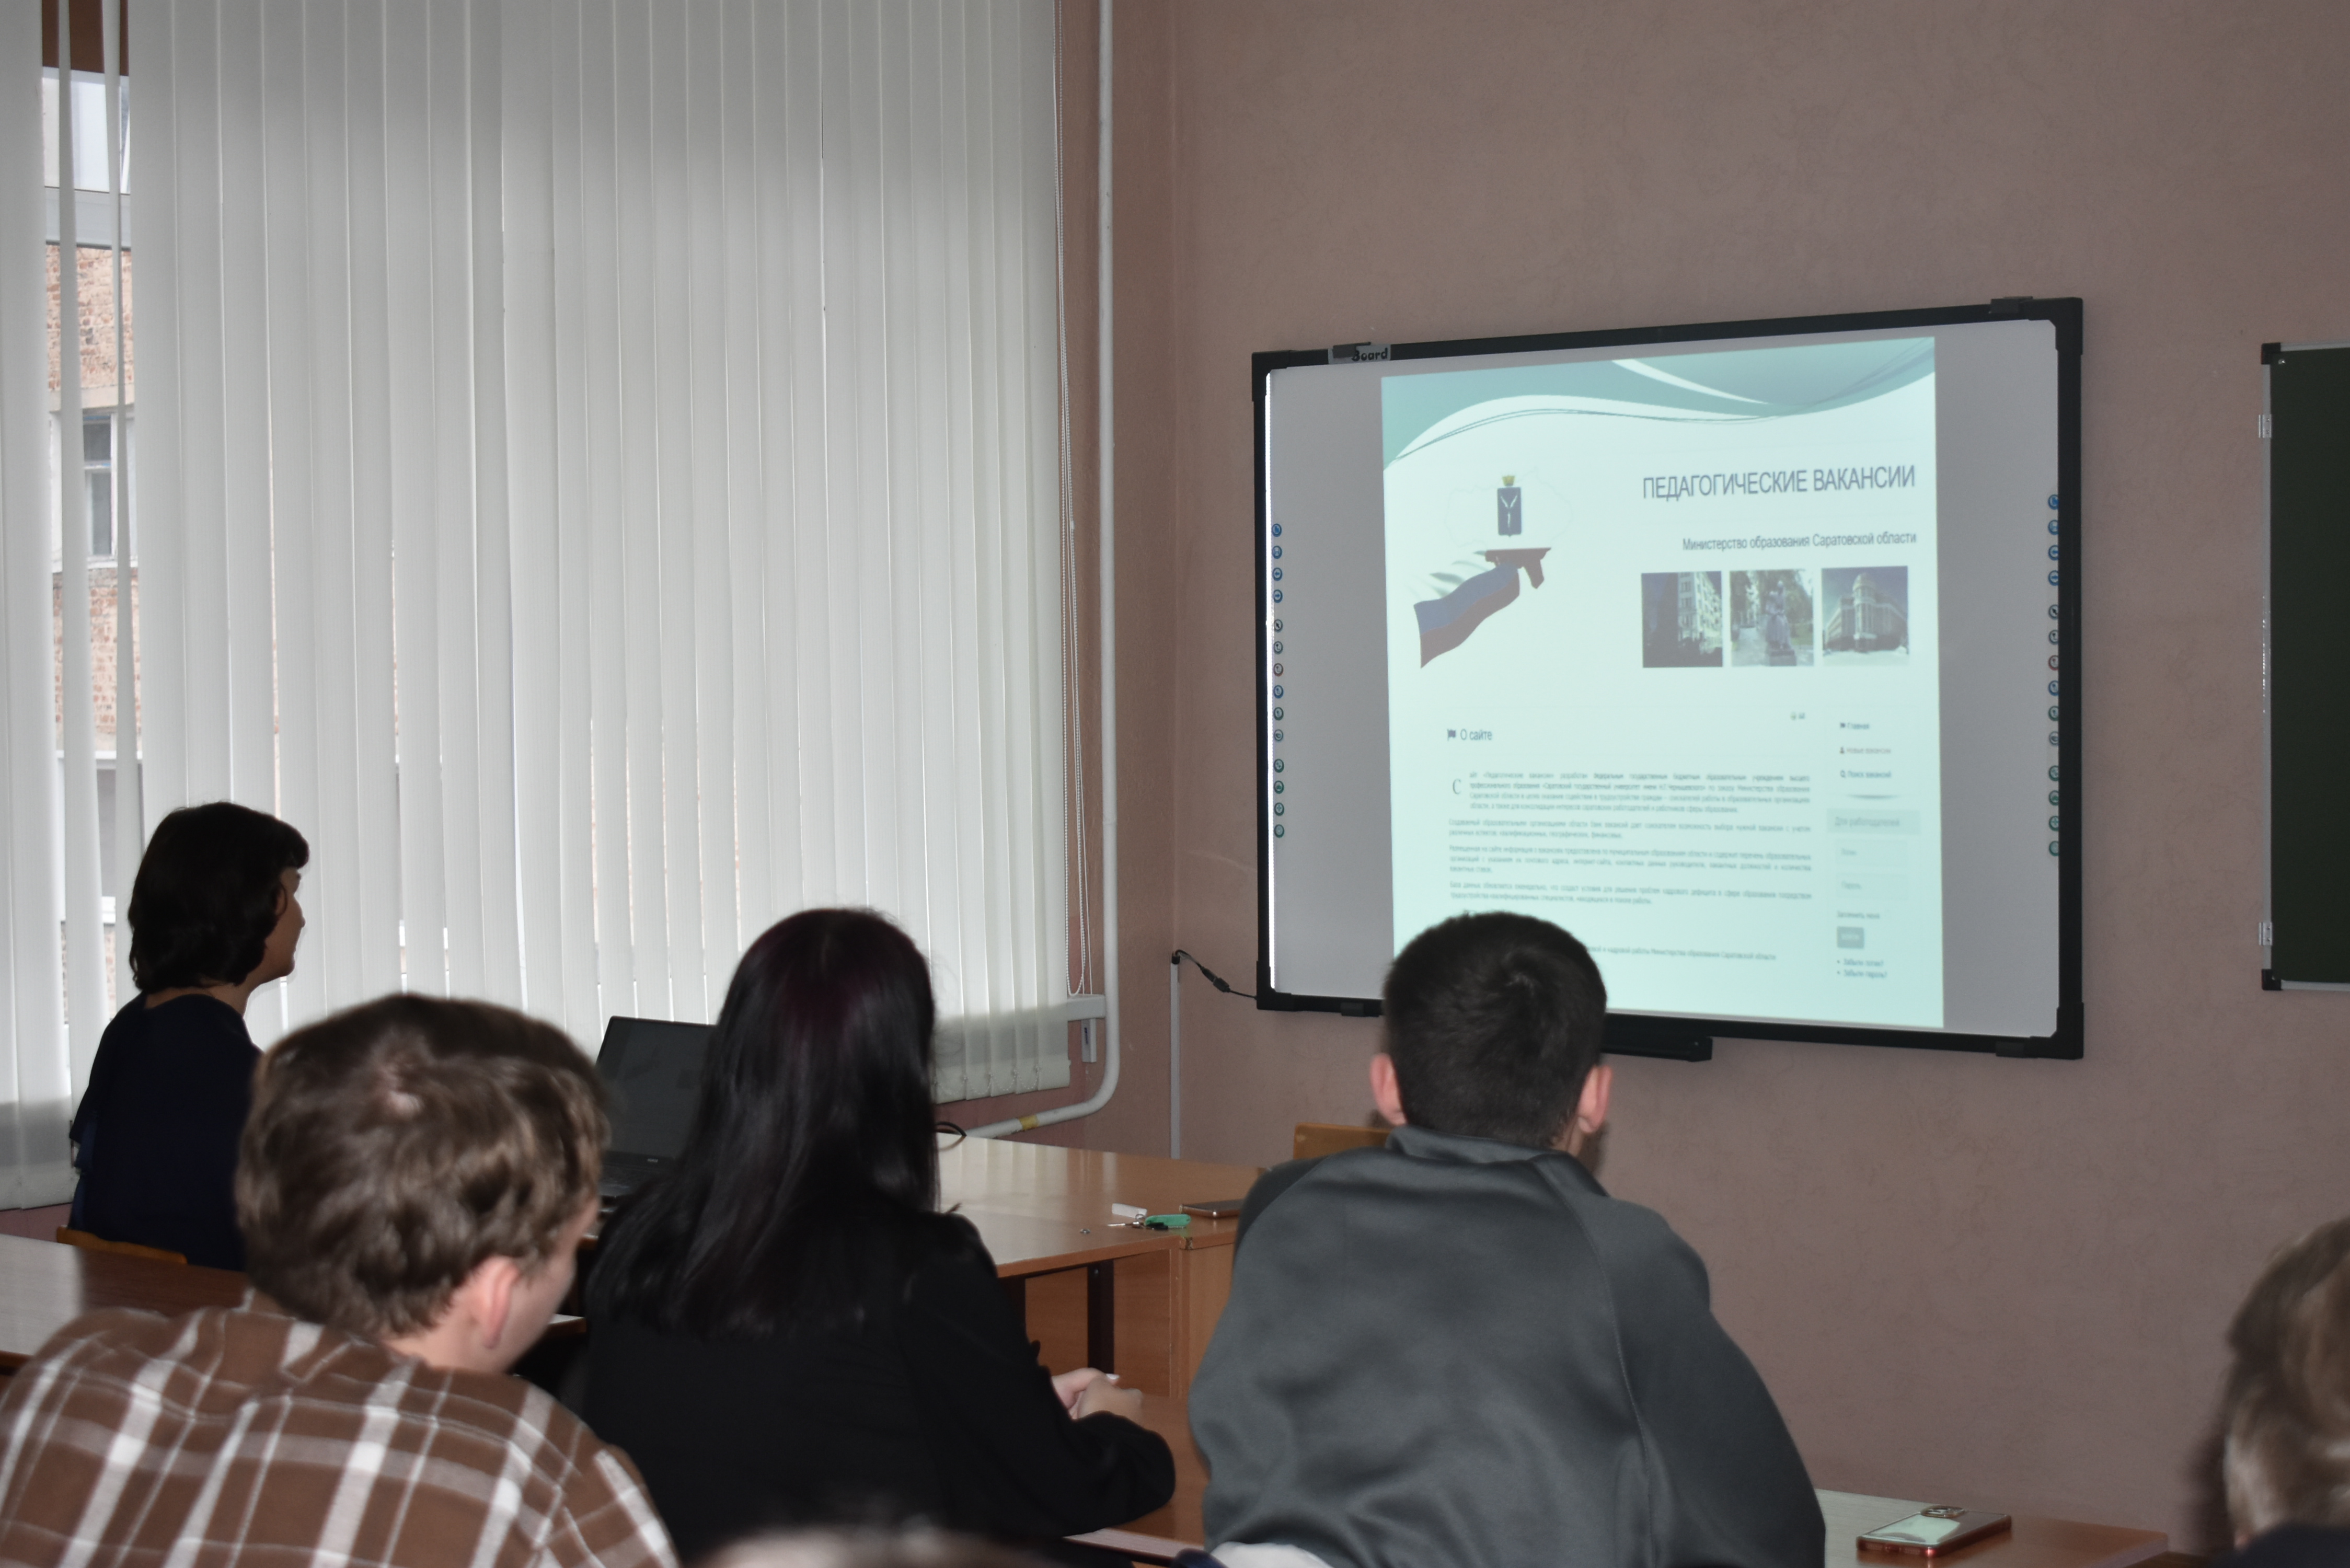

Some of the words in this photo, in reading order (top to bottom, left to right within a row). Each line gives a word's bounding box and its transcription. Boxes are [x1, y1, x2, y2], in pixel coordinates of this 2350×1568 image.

[1643, 469, 1807, 501] ПЕДАГОГИЧЕСКИЕ
[1813, 465, 1915, 492] ВАКАНСИИ
[1682, 537, 1747, 551] Министерство
[1749, 535, 1810, 549] образования
[1812, 532, 1874, 548] Саратовской
[1876, 531, 1916, 545] области
[1460, 729, 1467, 741] О
[1469, 729, 1492, 741] сайте
